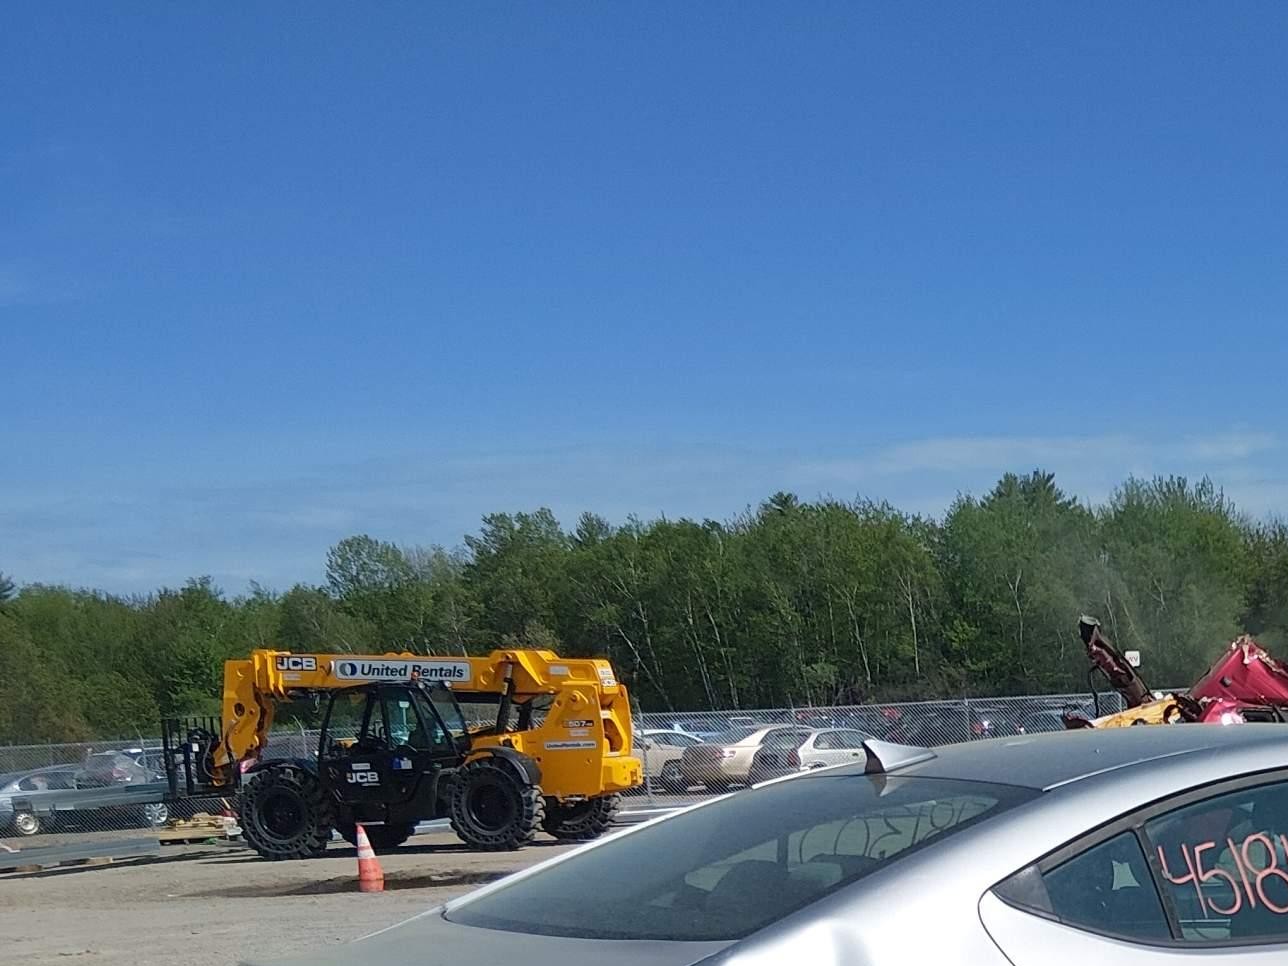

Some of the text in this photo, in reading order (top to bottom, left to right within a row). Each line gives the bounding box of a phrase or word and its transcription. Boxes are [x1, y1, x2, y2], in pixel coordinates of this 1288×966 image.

[277, 657, 317, 671] JCB
[360, 663, 465, 678] United Rentals
[346, 771, 379, 783] JCB
